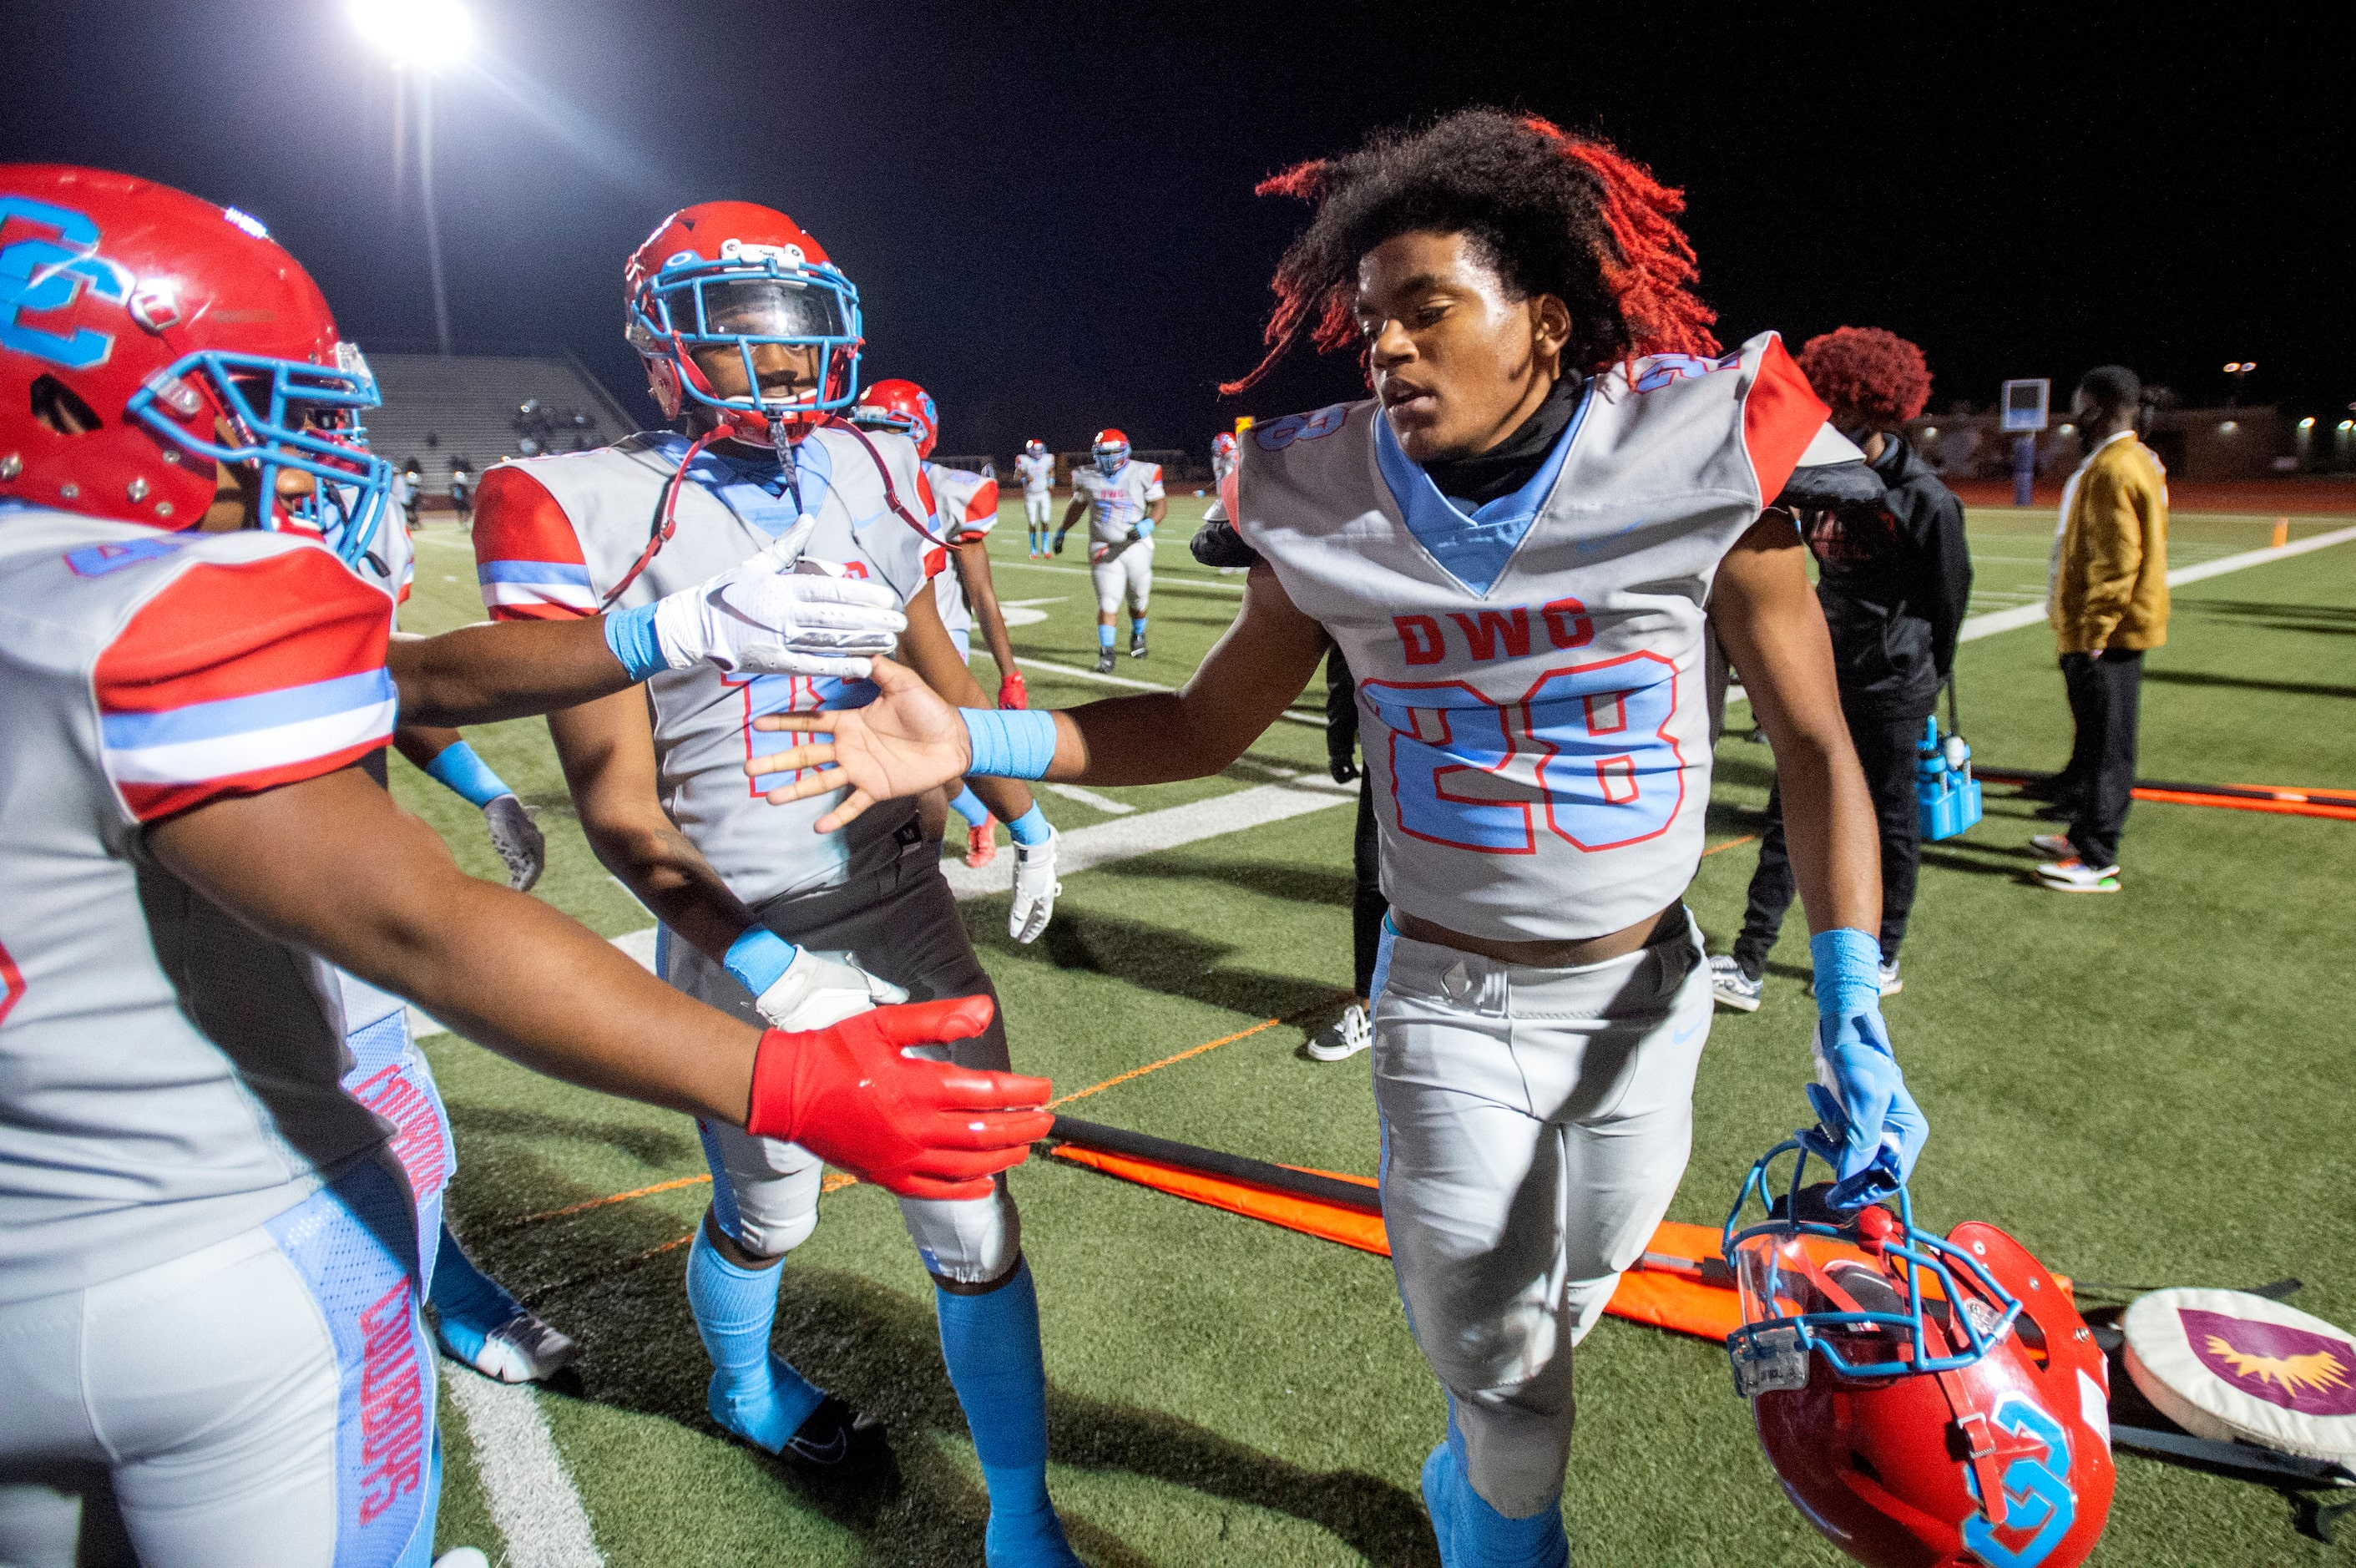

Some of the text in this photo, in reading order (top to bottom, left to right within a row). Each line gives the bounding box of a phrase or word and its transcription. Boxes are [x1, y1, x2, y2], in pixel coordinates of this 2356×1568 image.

[1095, 498, 1134, 524] 77
[1392, 596, 1596, 666] DWC
[1360, 649, 1686, 856] 28
[359, 1274, 424, 1526] COWBOYS
